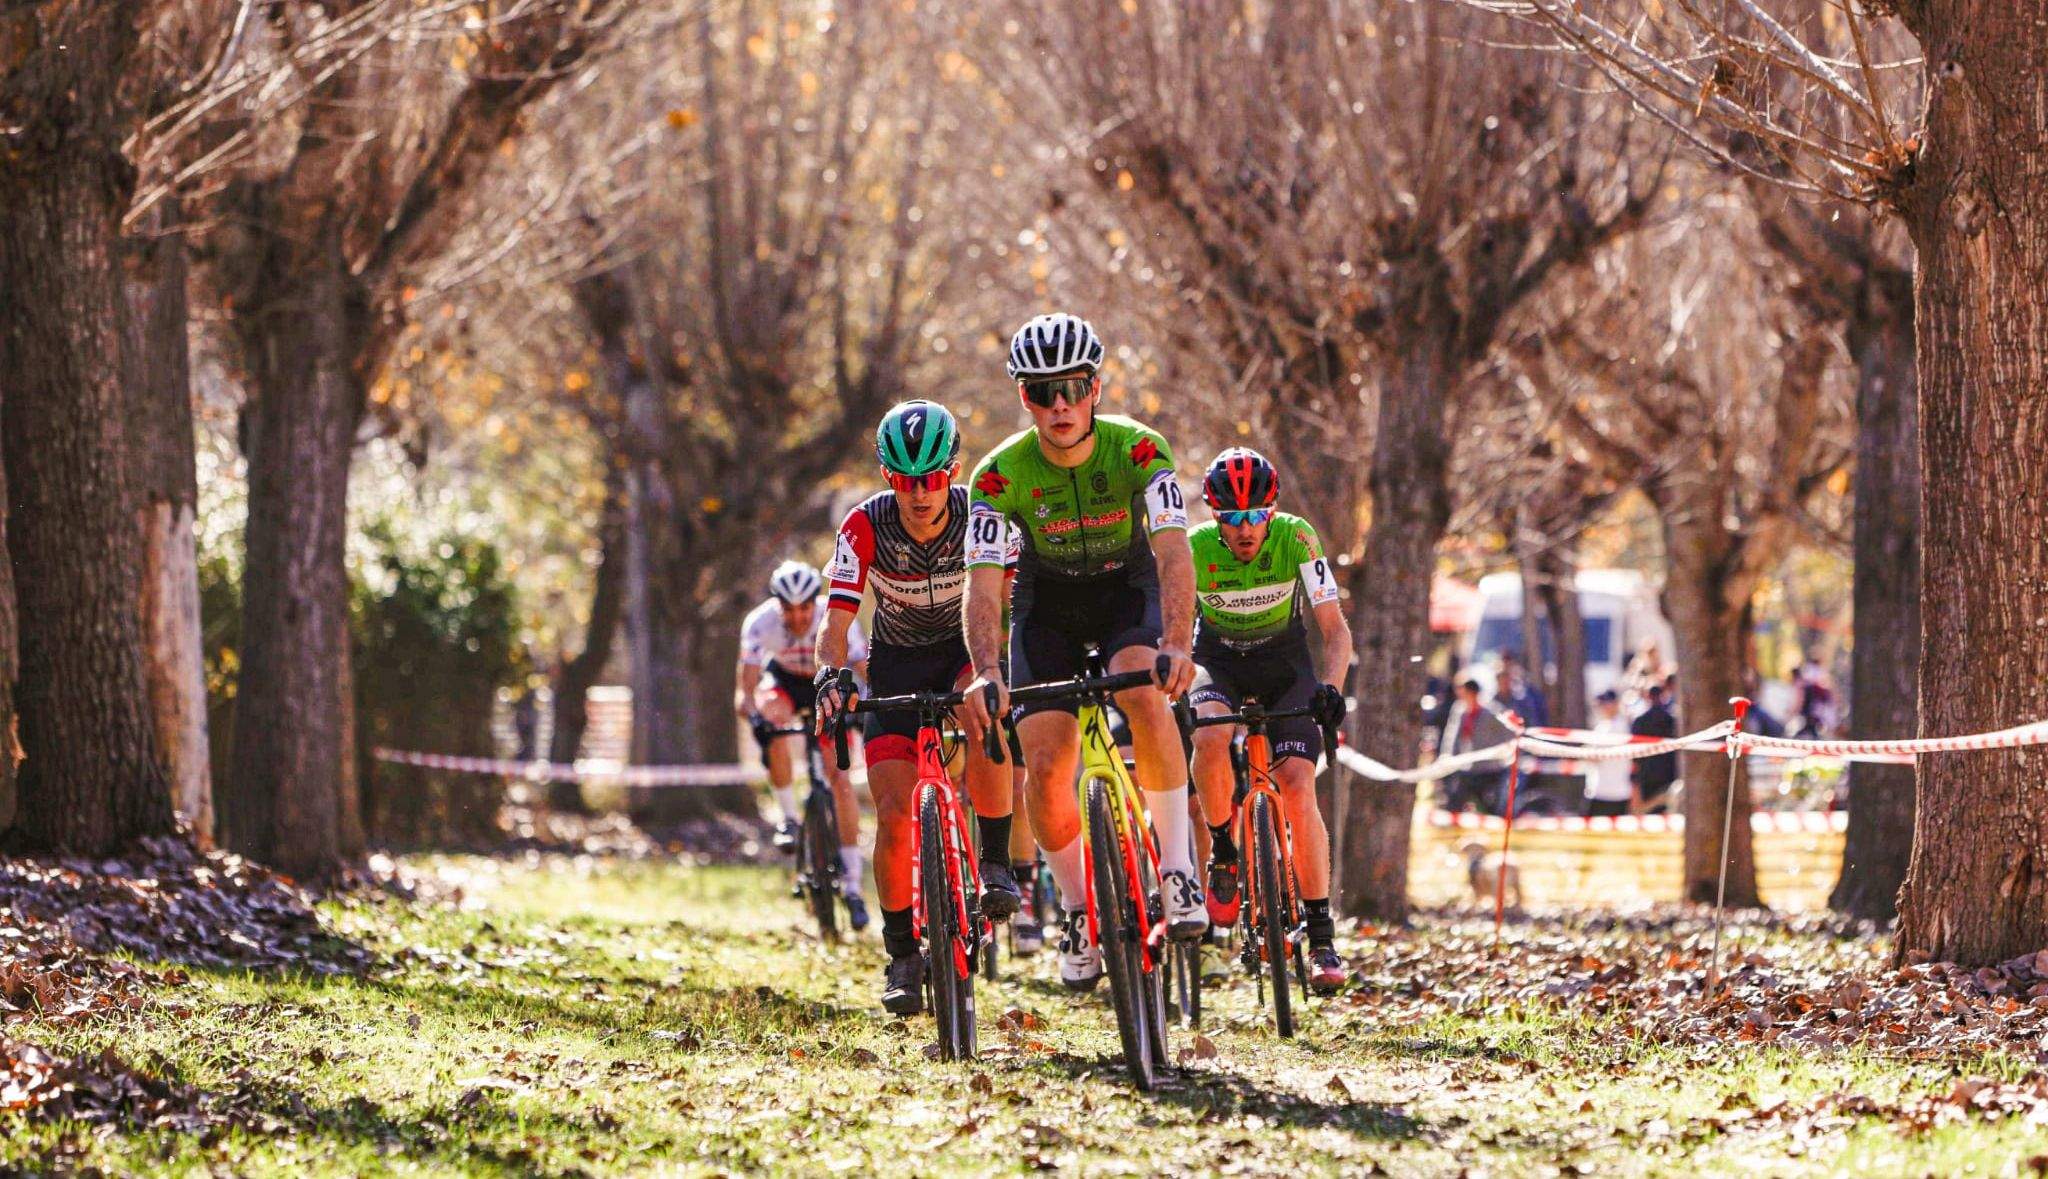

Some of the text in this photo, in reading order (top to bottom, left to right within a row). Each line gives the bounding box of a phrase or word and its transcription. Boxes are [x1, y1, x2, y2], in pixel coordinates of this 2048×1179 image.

[1158, 482, 1183, 509] 10
[973, 517, 998, 544] 10
[1315, 560, 1325, 585] 9
[1231, 591, 1281, 604] RENAULT
